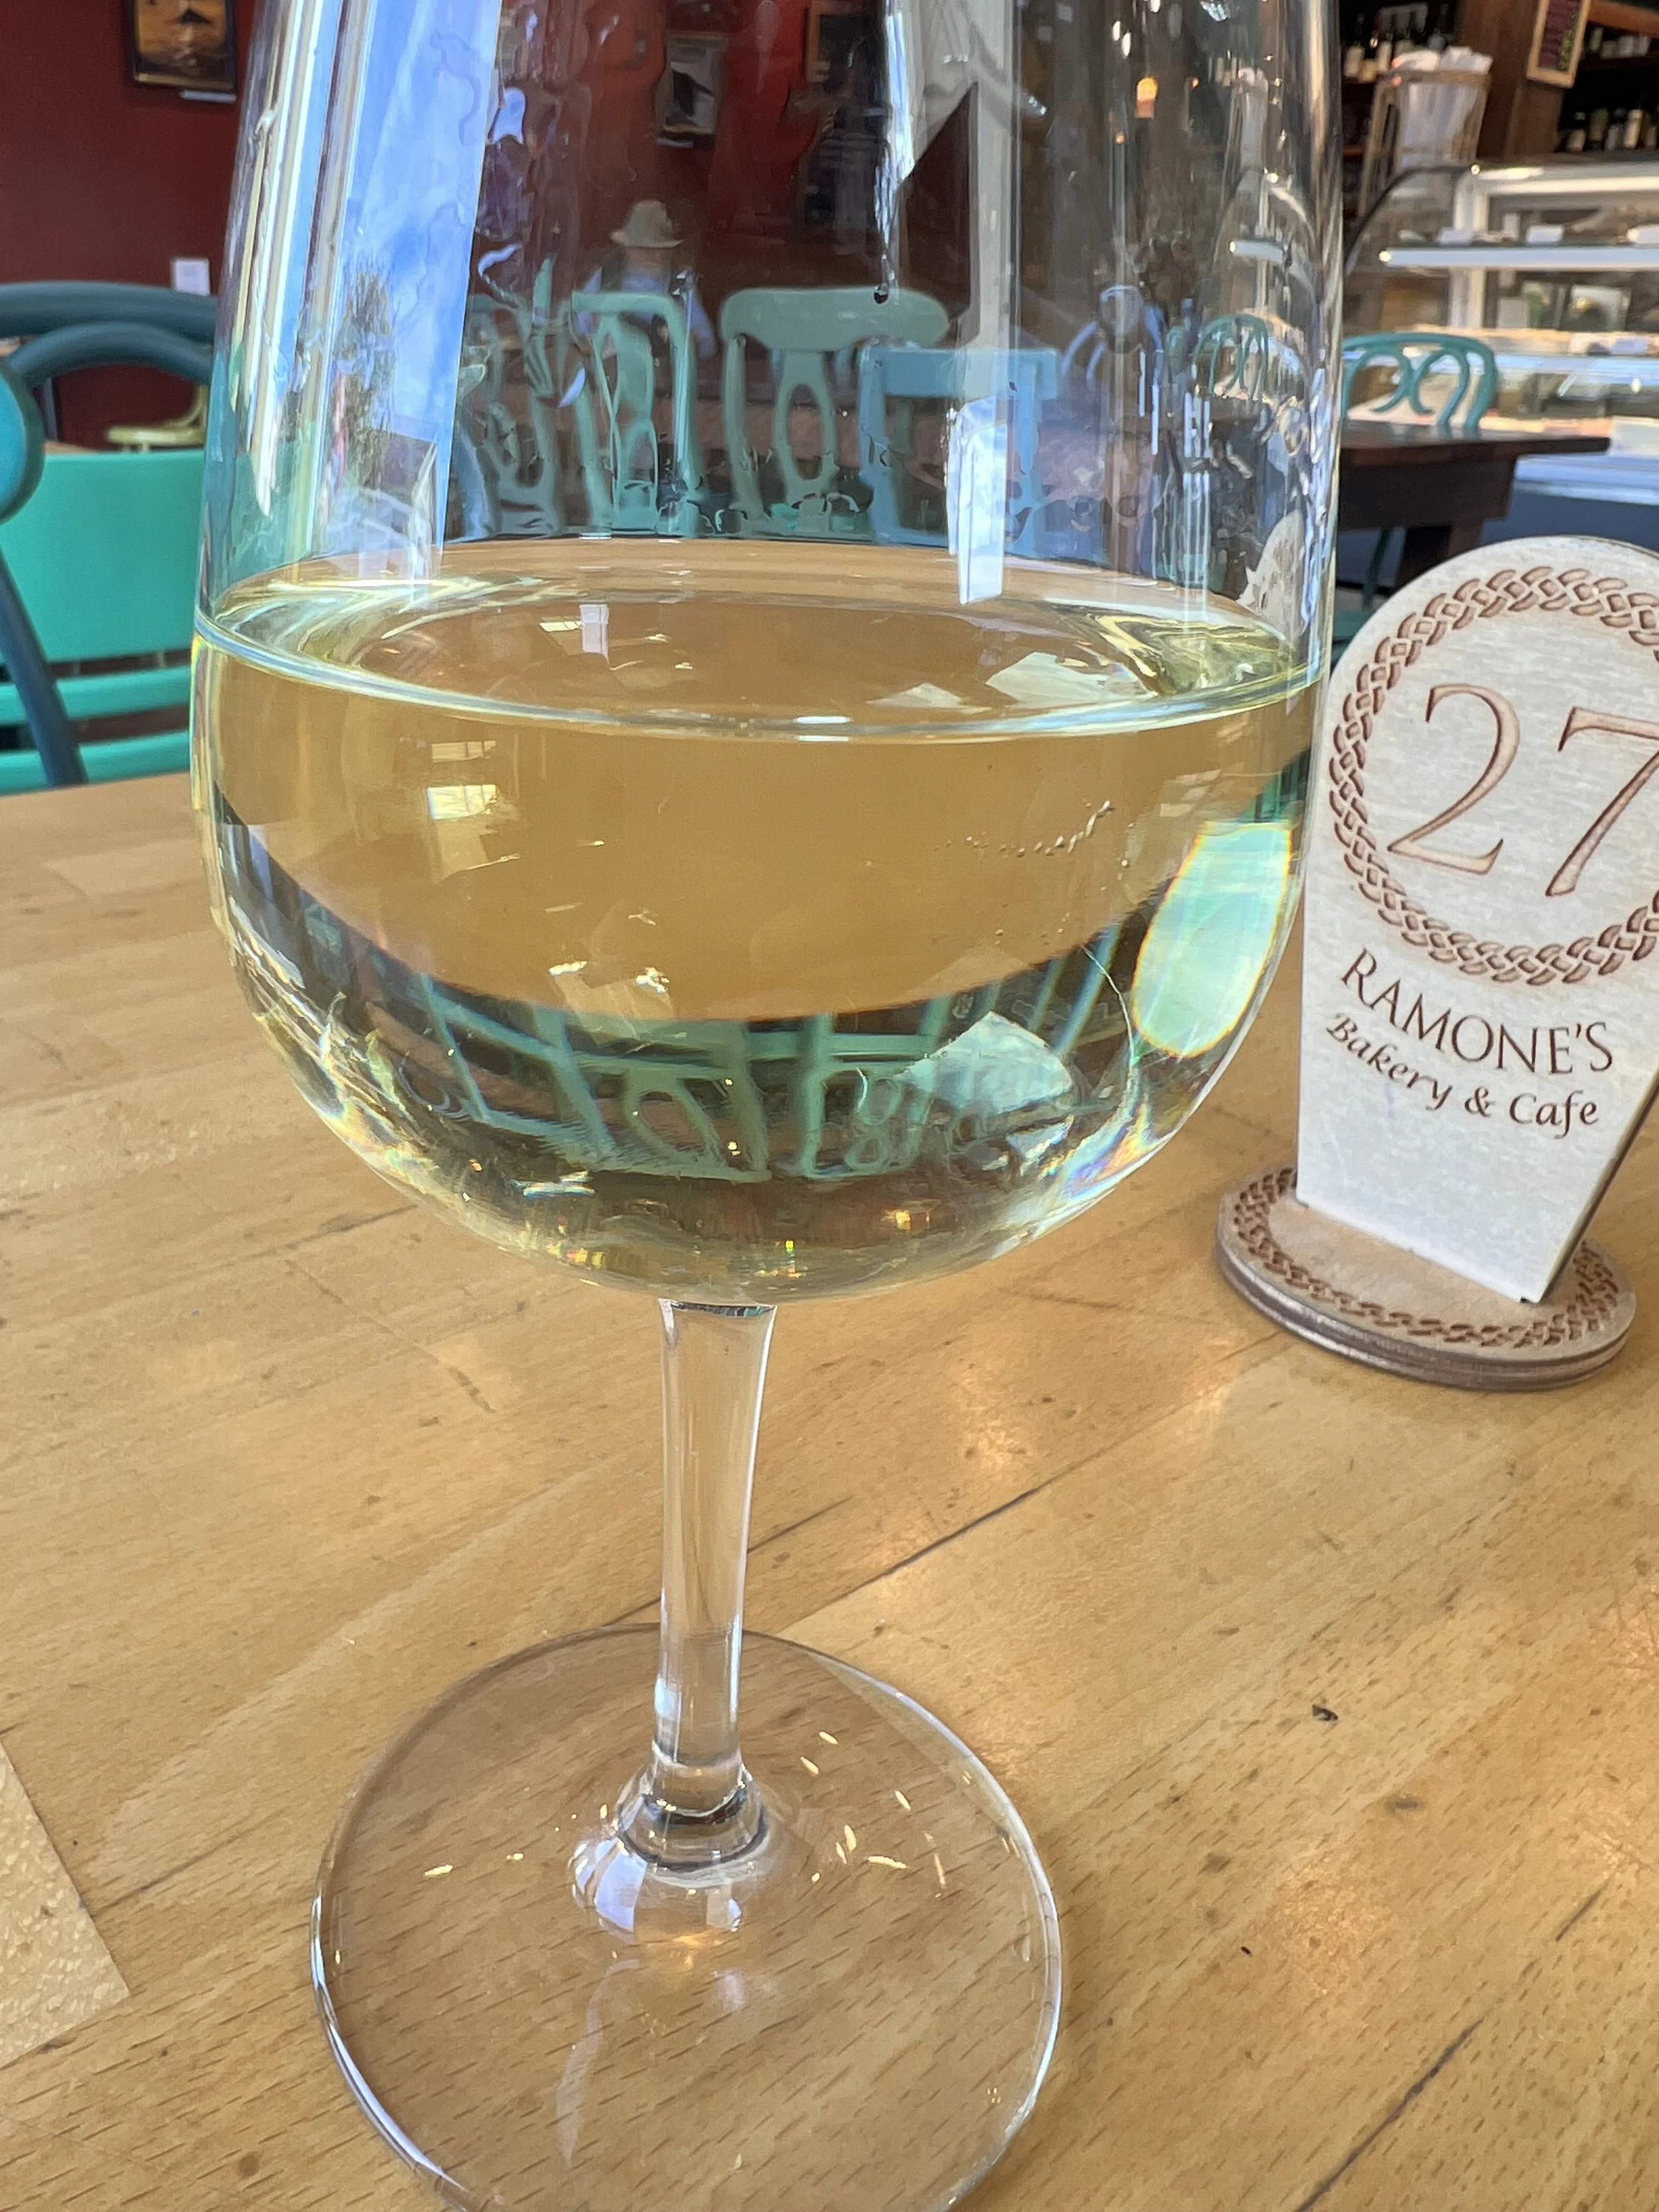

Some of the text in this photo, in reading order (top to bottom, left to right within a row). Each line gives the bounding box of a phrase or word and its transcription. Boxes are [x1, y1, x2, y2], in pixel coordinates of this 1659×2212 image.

[1387, 683, 1659, 897] 27
[1340, 948, 1613, 1074] RAMONE'S
[1325, 1012, 1599, 1140] Bakery & Cafe
